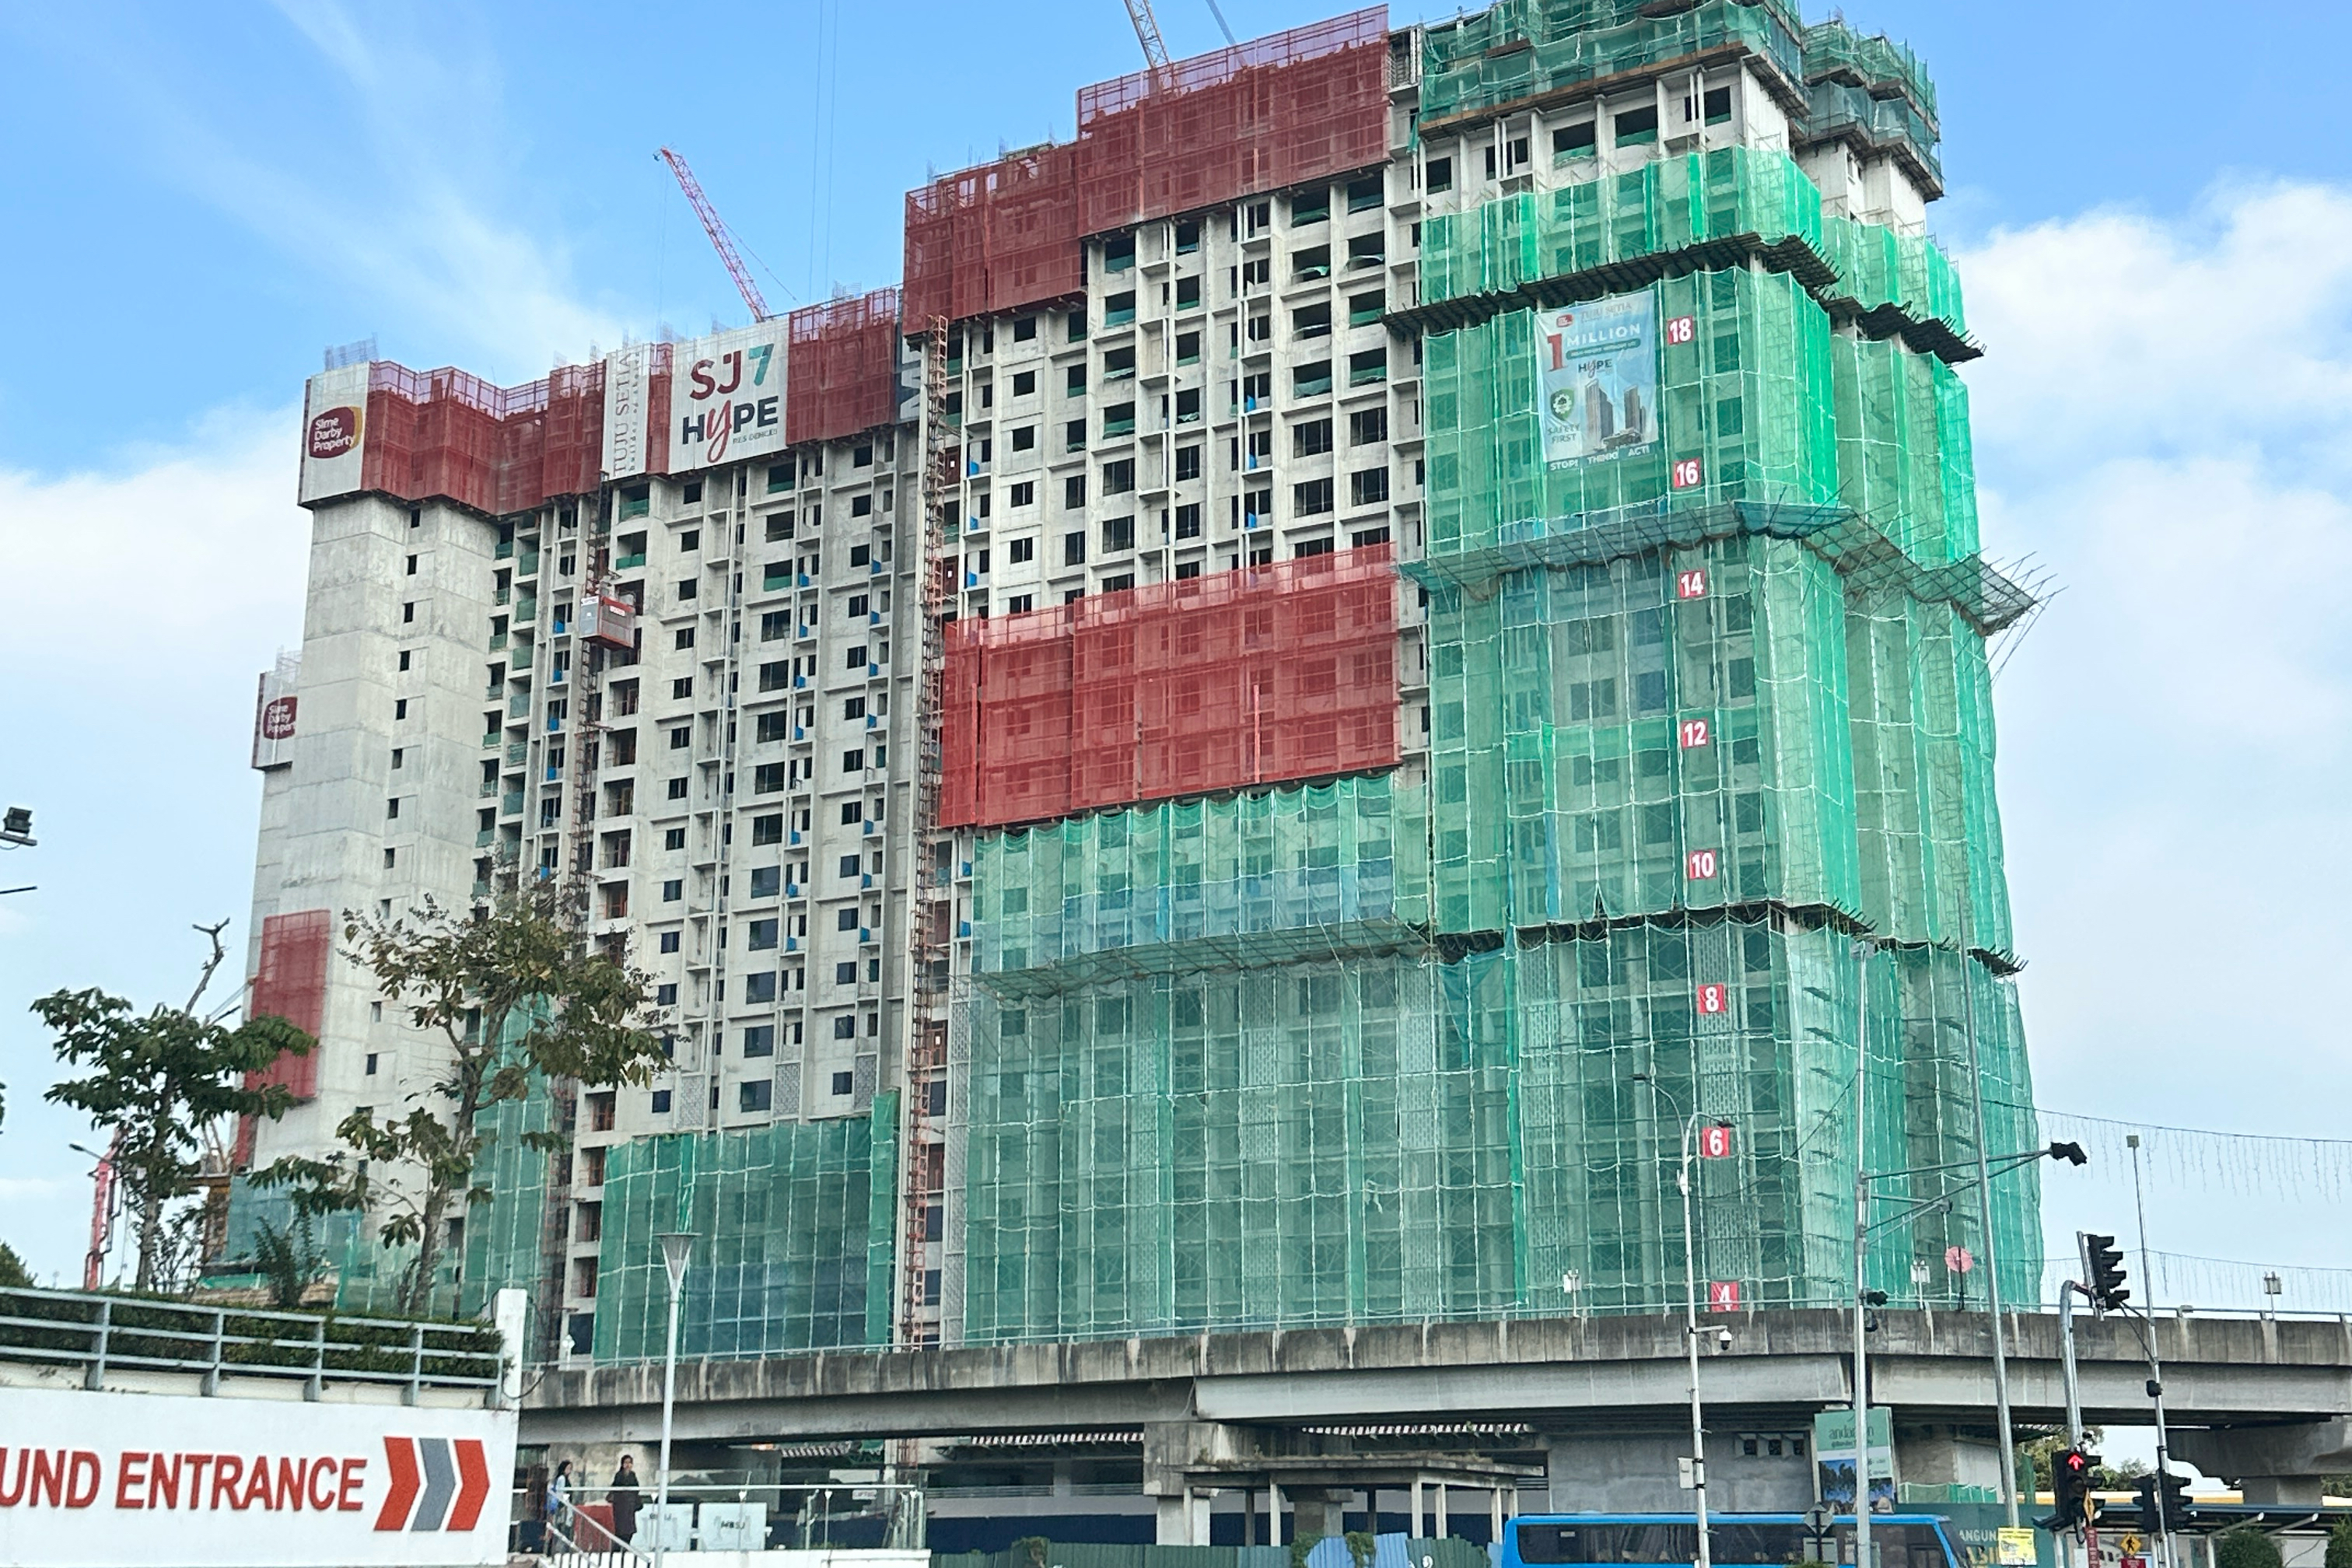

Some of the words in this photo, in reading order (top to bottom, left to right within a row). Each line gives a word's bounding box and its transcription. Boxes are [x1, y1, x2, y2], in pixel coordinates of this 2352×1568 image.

[1566, 323, 1640, 347] MILLION
[1669, 318, 1692, 342] 18
[615, 352, 632, 416] SETIA
[313, 427, 343, 442] Darby
[315, 417, 339, 431] Sime
[313, 435, 355, 453] Property
[613, 422, 628, 477] TUJU
[1551, 433, 1577, 444] FIRST
[1676, 460, 1699, 485] 16
[1681, 572, 1703, 597] 14
[1684, 722, 1706, 745] 12
[1692, 853, 1714, 877] 10
[1704, 987, 1720, 1011] 8
[1709, 1129, 1724, 1156] 6
[1719, 1285, 1731, 1312] 4
[0, 1447, 101, 1509] UND
[115, 1451, 368, 1511] ENTRANCE
